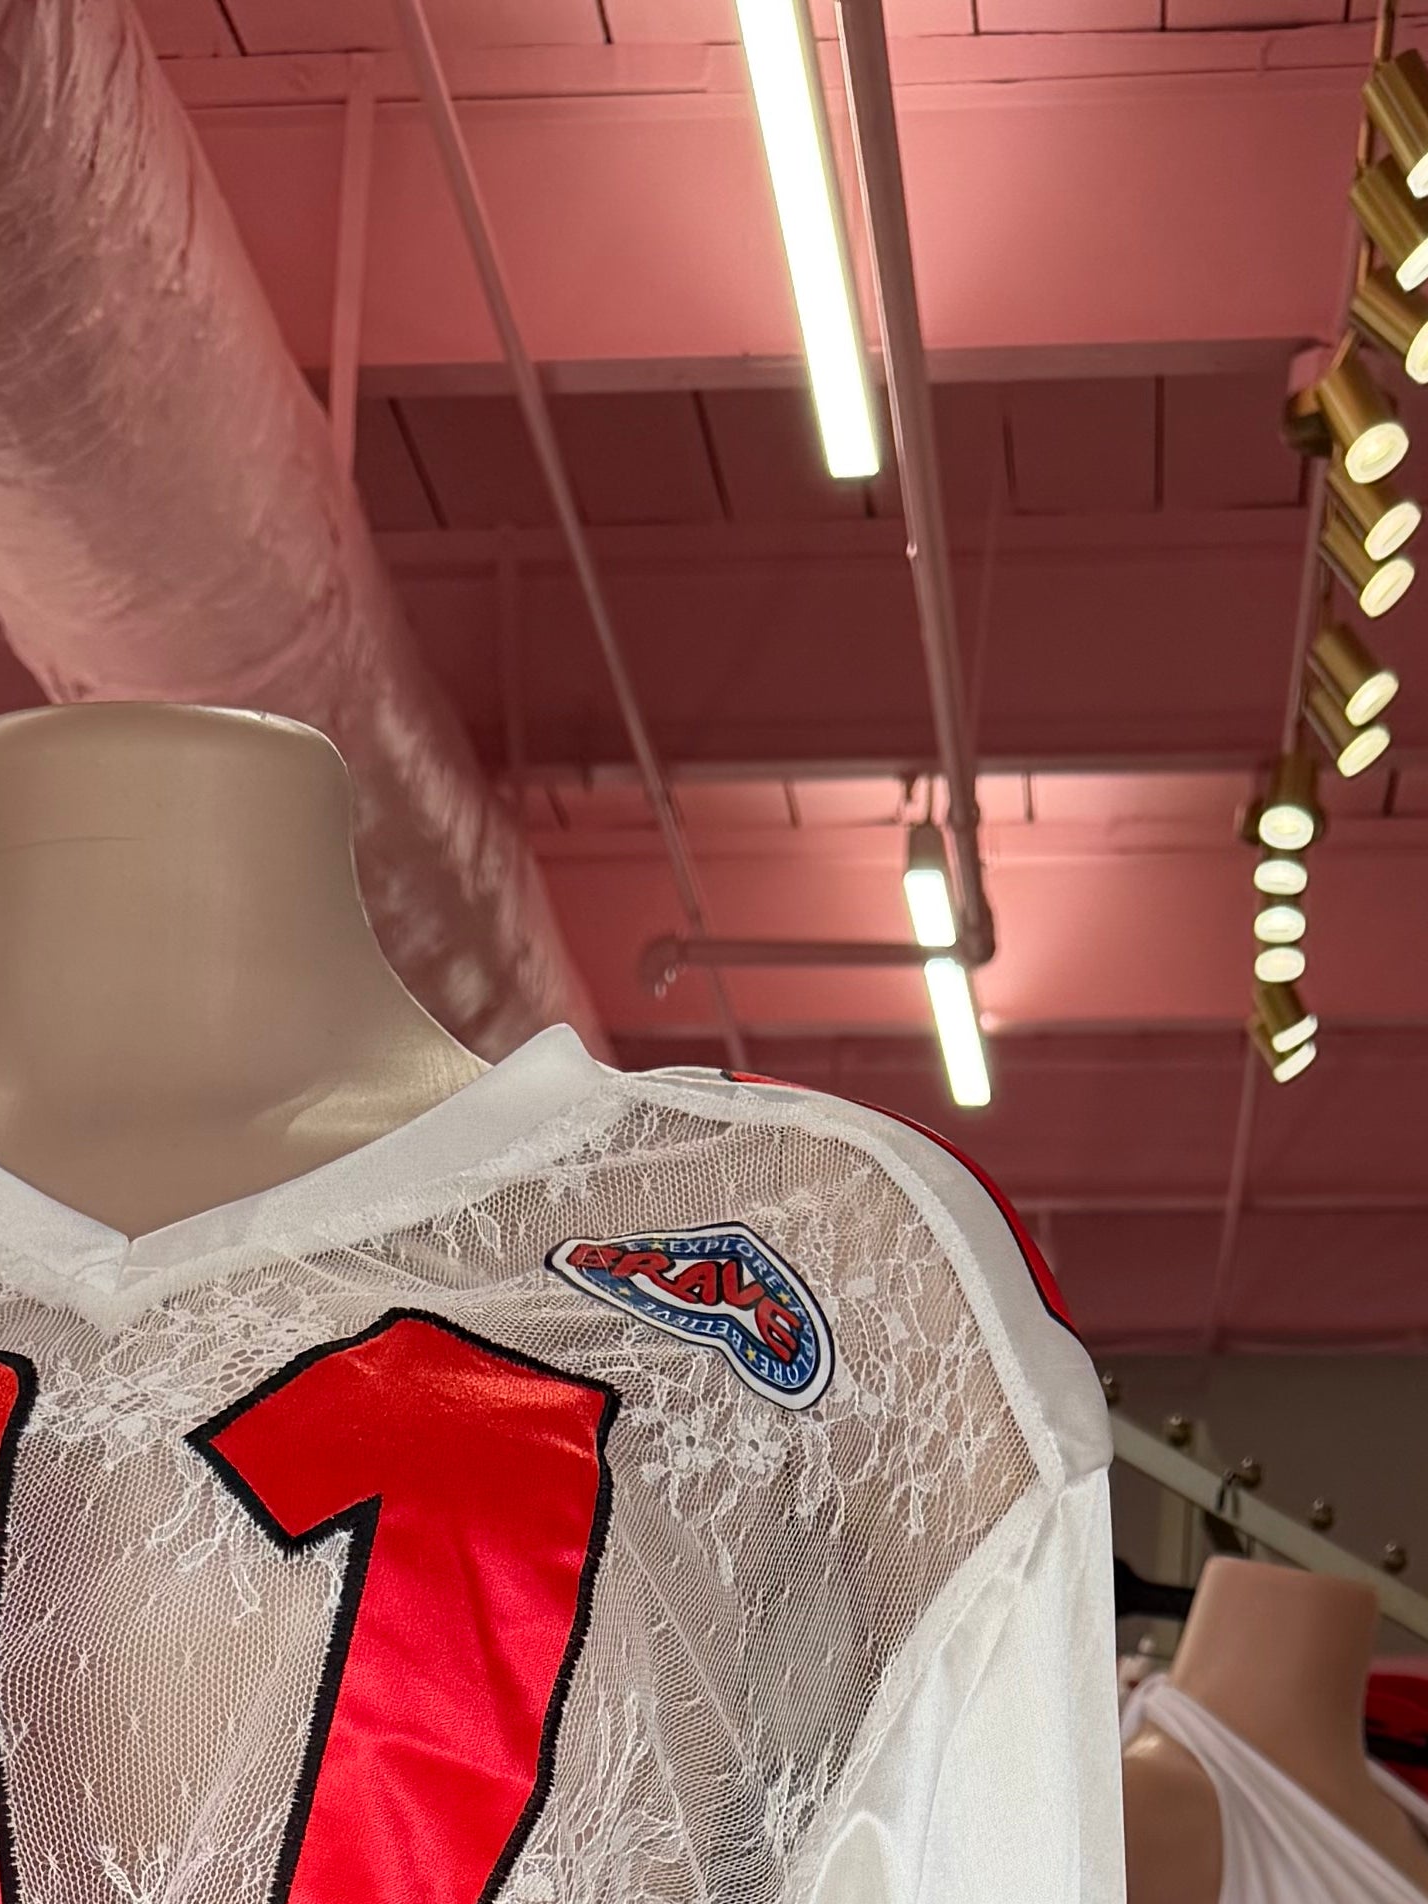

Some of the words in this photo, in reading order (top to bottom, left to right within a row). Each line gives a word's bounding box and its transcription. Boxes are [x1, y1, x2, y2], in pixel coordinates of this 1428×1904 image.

[565, 1243, 802, 1364] BRAVE
[669, 1237, 782, 1304] EXPLORE
[637, 1301, 744, 1351] BELIEVE
